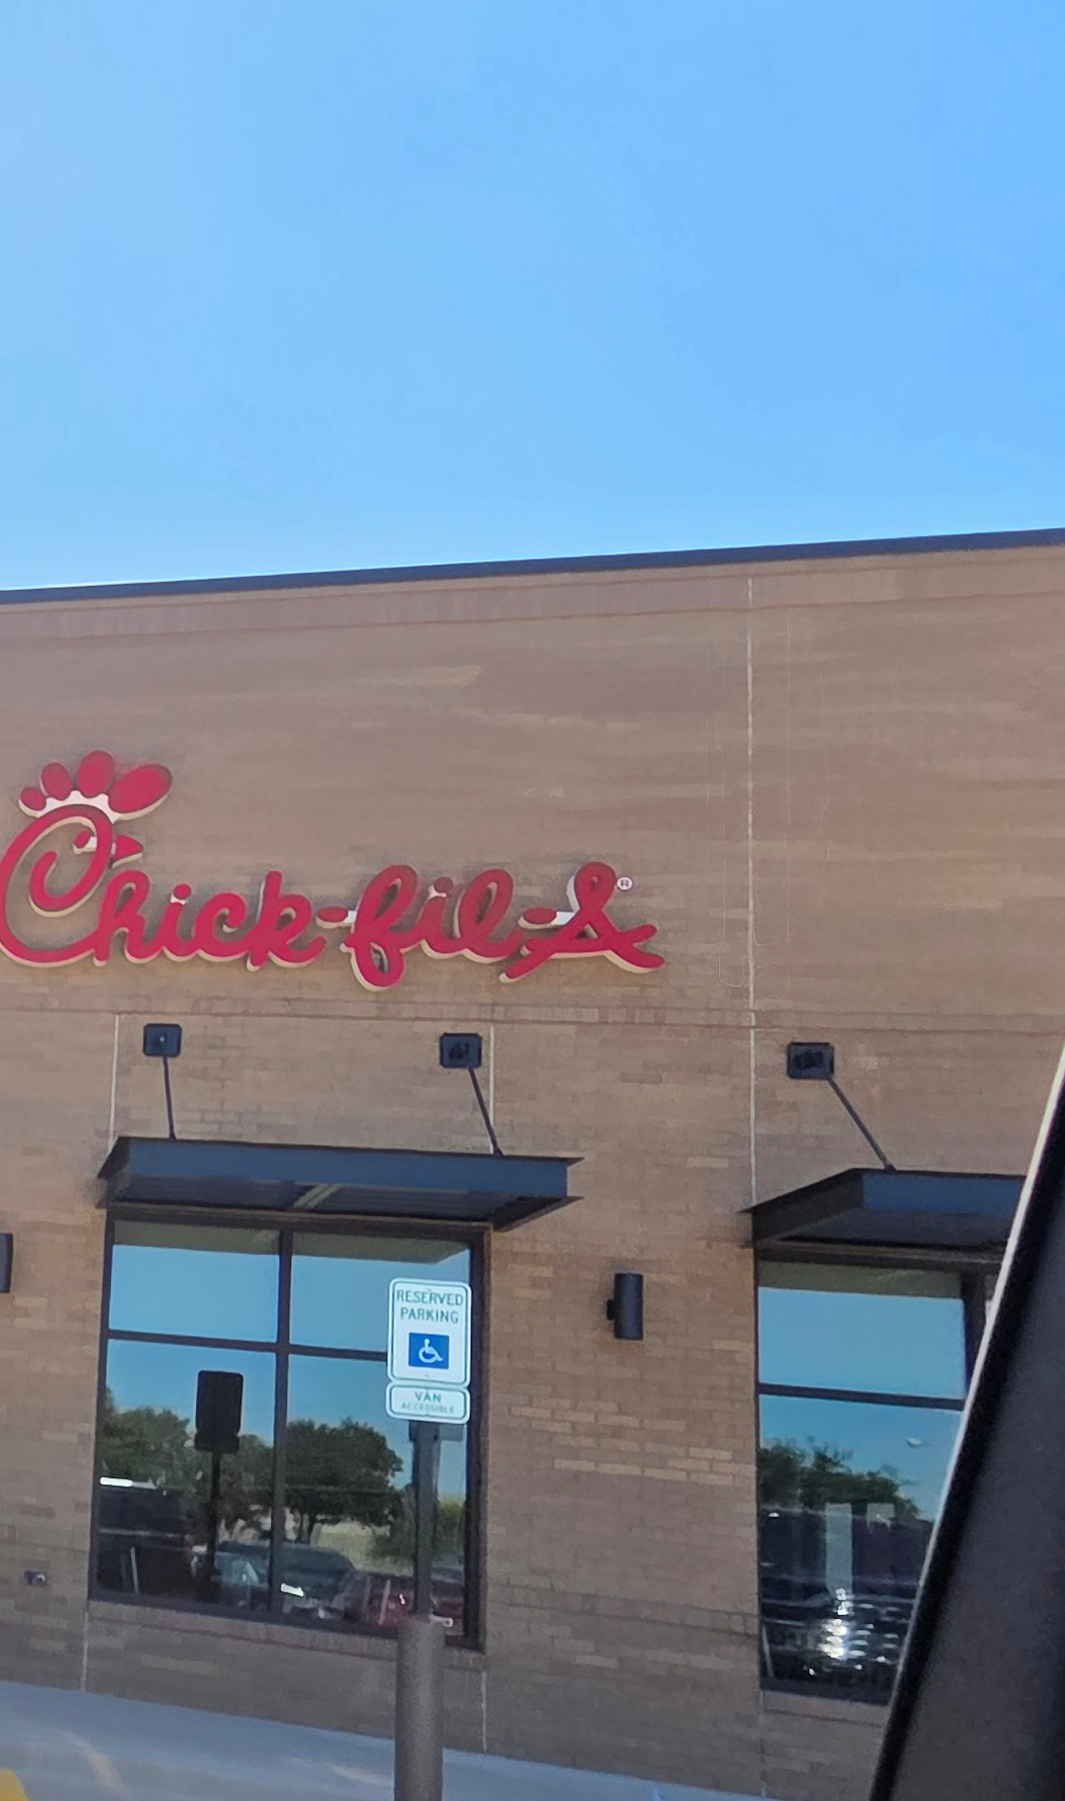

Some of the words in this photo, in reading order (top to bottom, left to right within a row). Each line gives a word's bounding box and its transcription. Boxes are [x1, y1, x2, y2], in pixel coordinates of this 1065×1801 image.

[396, 1289, 464, 1307] RESERVED
[400, 1307, 459, 1324] PARKING
[414, 1391, 442, 1403] VAN
[401, 1401, 455, 1415] ACCESSIBLE
